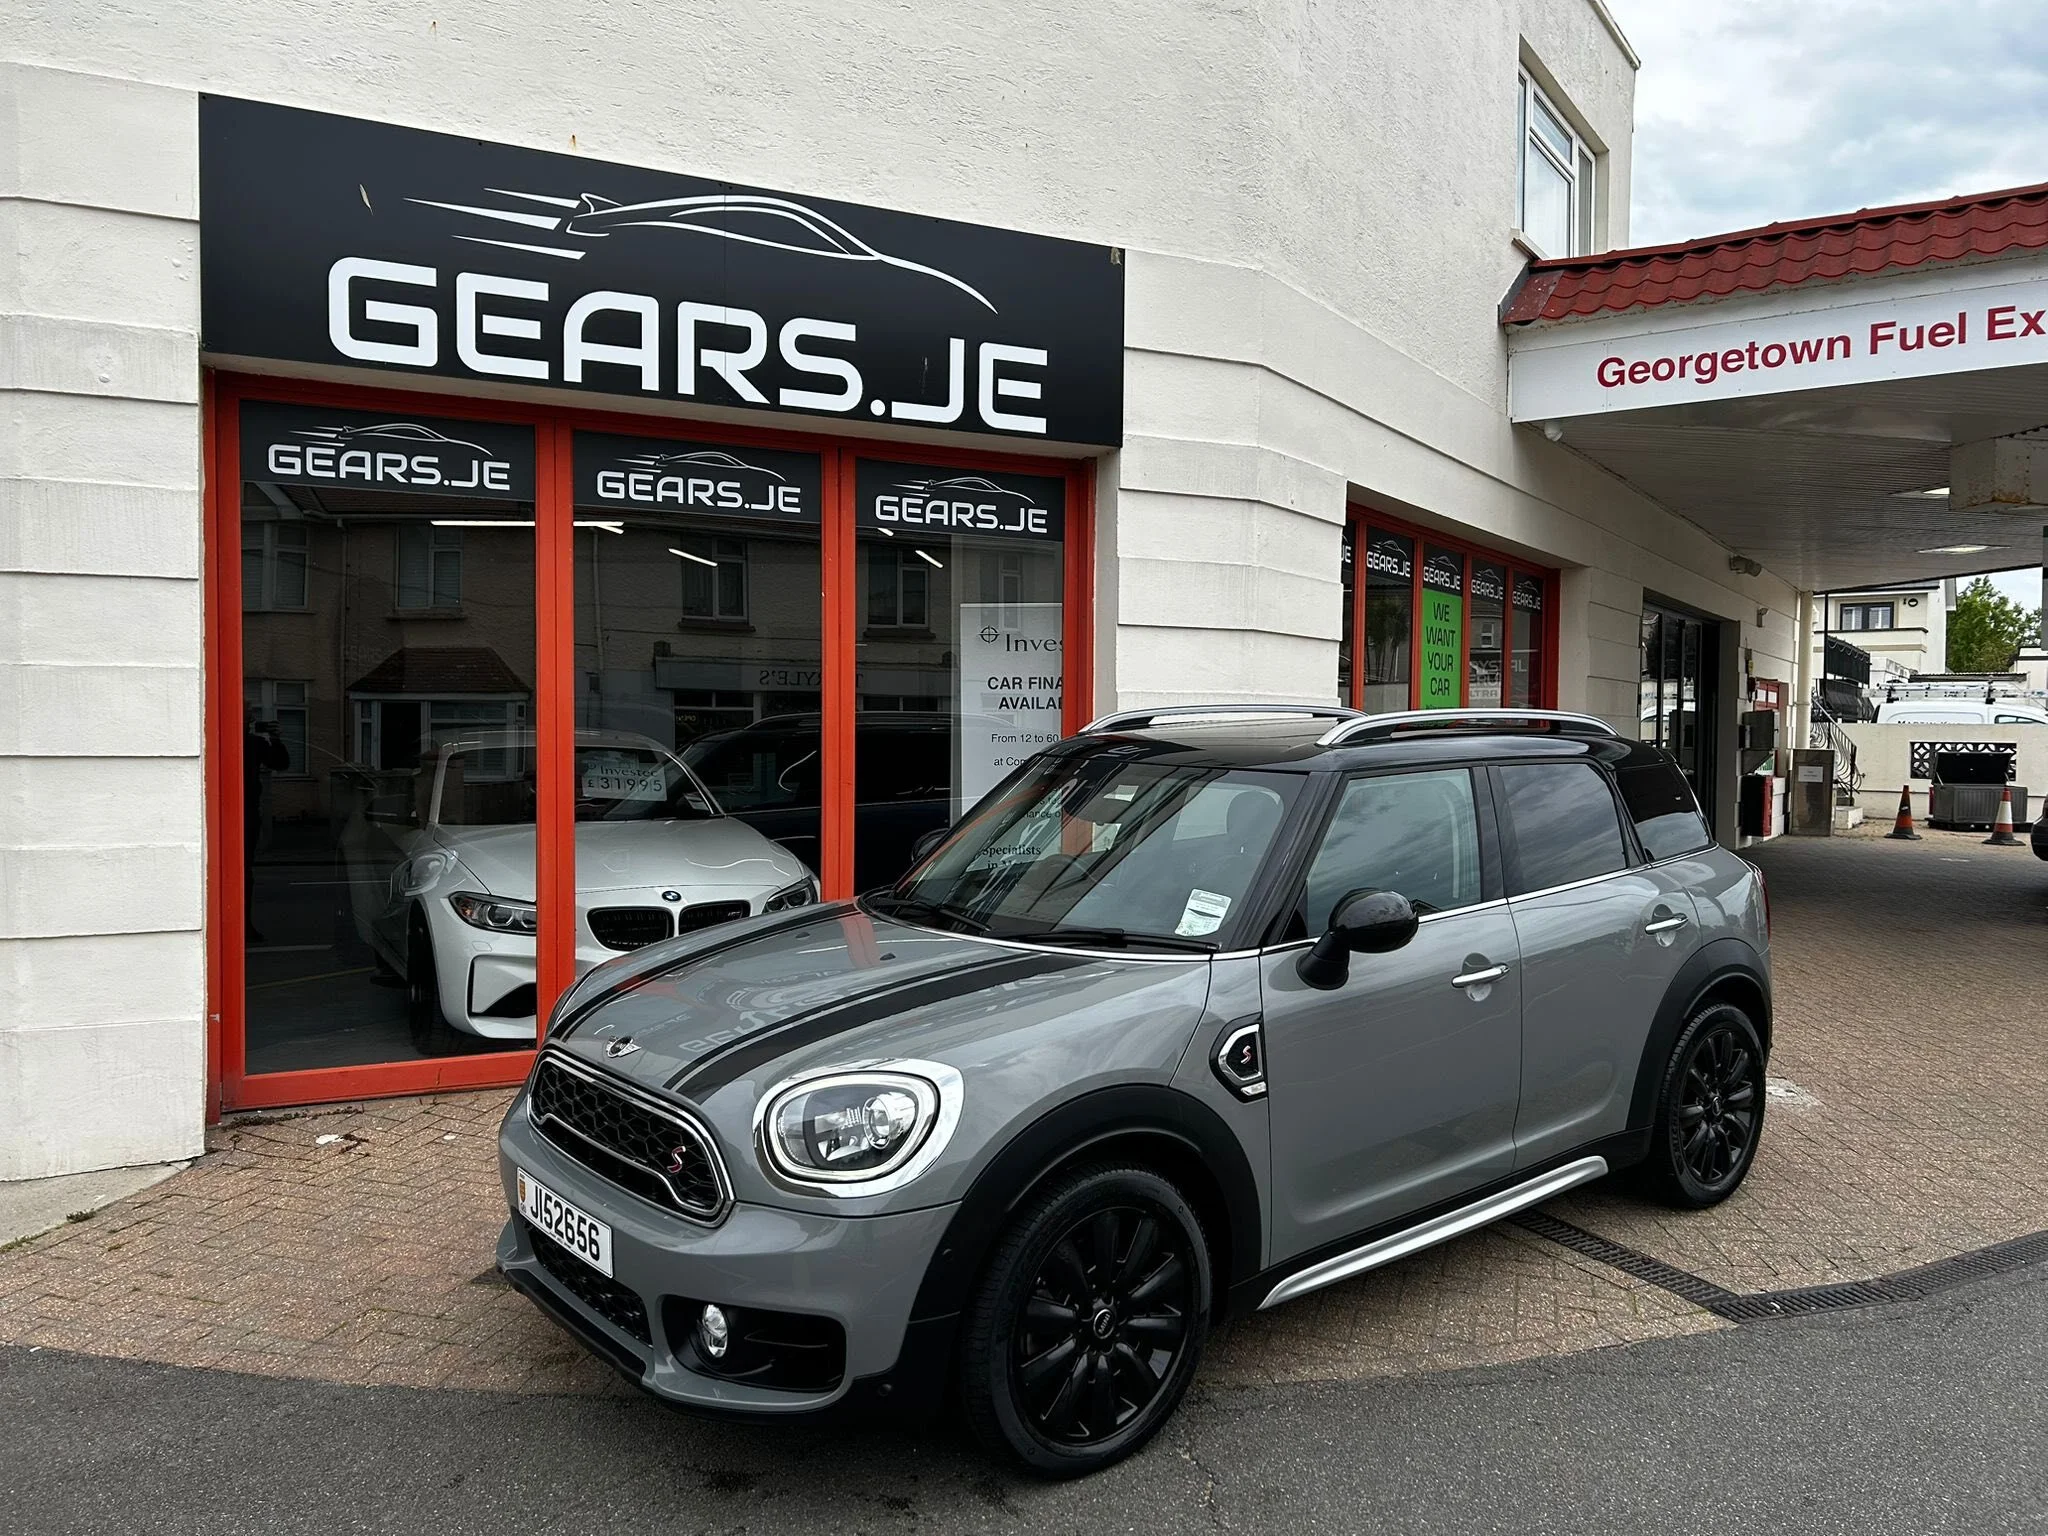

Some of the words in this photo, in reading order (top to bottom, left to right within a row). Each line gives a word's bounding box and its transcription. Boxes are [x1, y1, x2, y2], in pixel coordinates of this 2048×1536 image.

[328, 256, 1048, 434] GEARS.JE
[1597, 333, 1852, 387] Georgetown
[1870, 312, 1966, 355] Fuel
[268, 444, 511, 491] GEARS.JE
[596, 470, 802, 514] GEARS.JE
[874, 495, 1049, 535] GEARS.JE
[1366, 551, 1411, 579] GEARS.JE
[1423, 566, 1461, 591] GEARS.JE
[1471, 579, 1504, 600] GEARS.JE
[1433, 602, 1450, 623] WE
[1426, 625, 1456, 646] WANT
[1428, 651, 1454, 672] YOUR
[987, 676, 1023, 690] CAR
[1430, 677, 1450, 697] CAR
[991, 733, 1017, 743] From
[1020, 733, 1032, 743] 12
[1034, 733, 1044, 743] to
[1046, 733, 1059, 743] 60
[994, 757, 1004, 767] at
[982, 844, 1042, 857] Specialists
